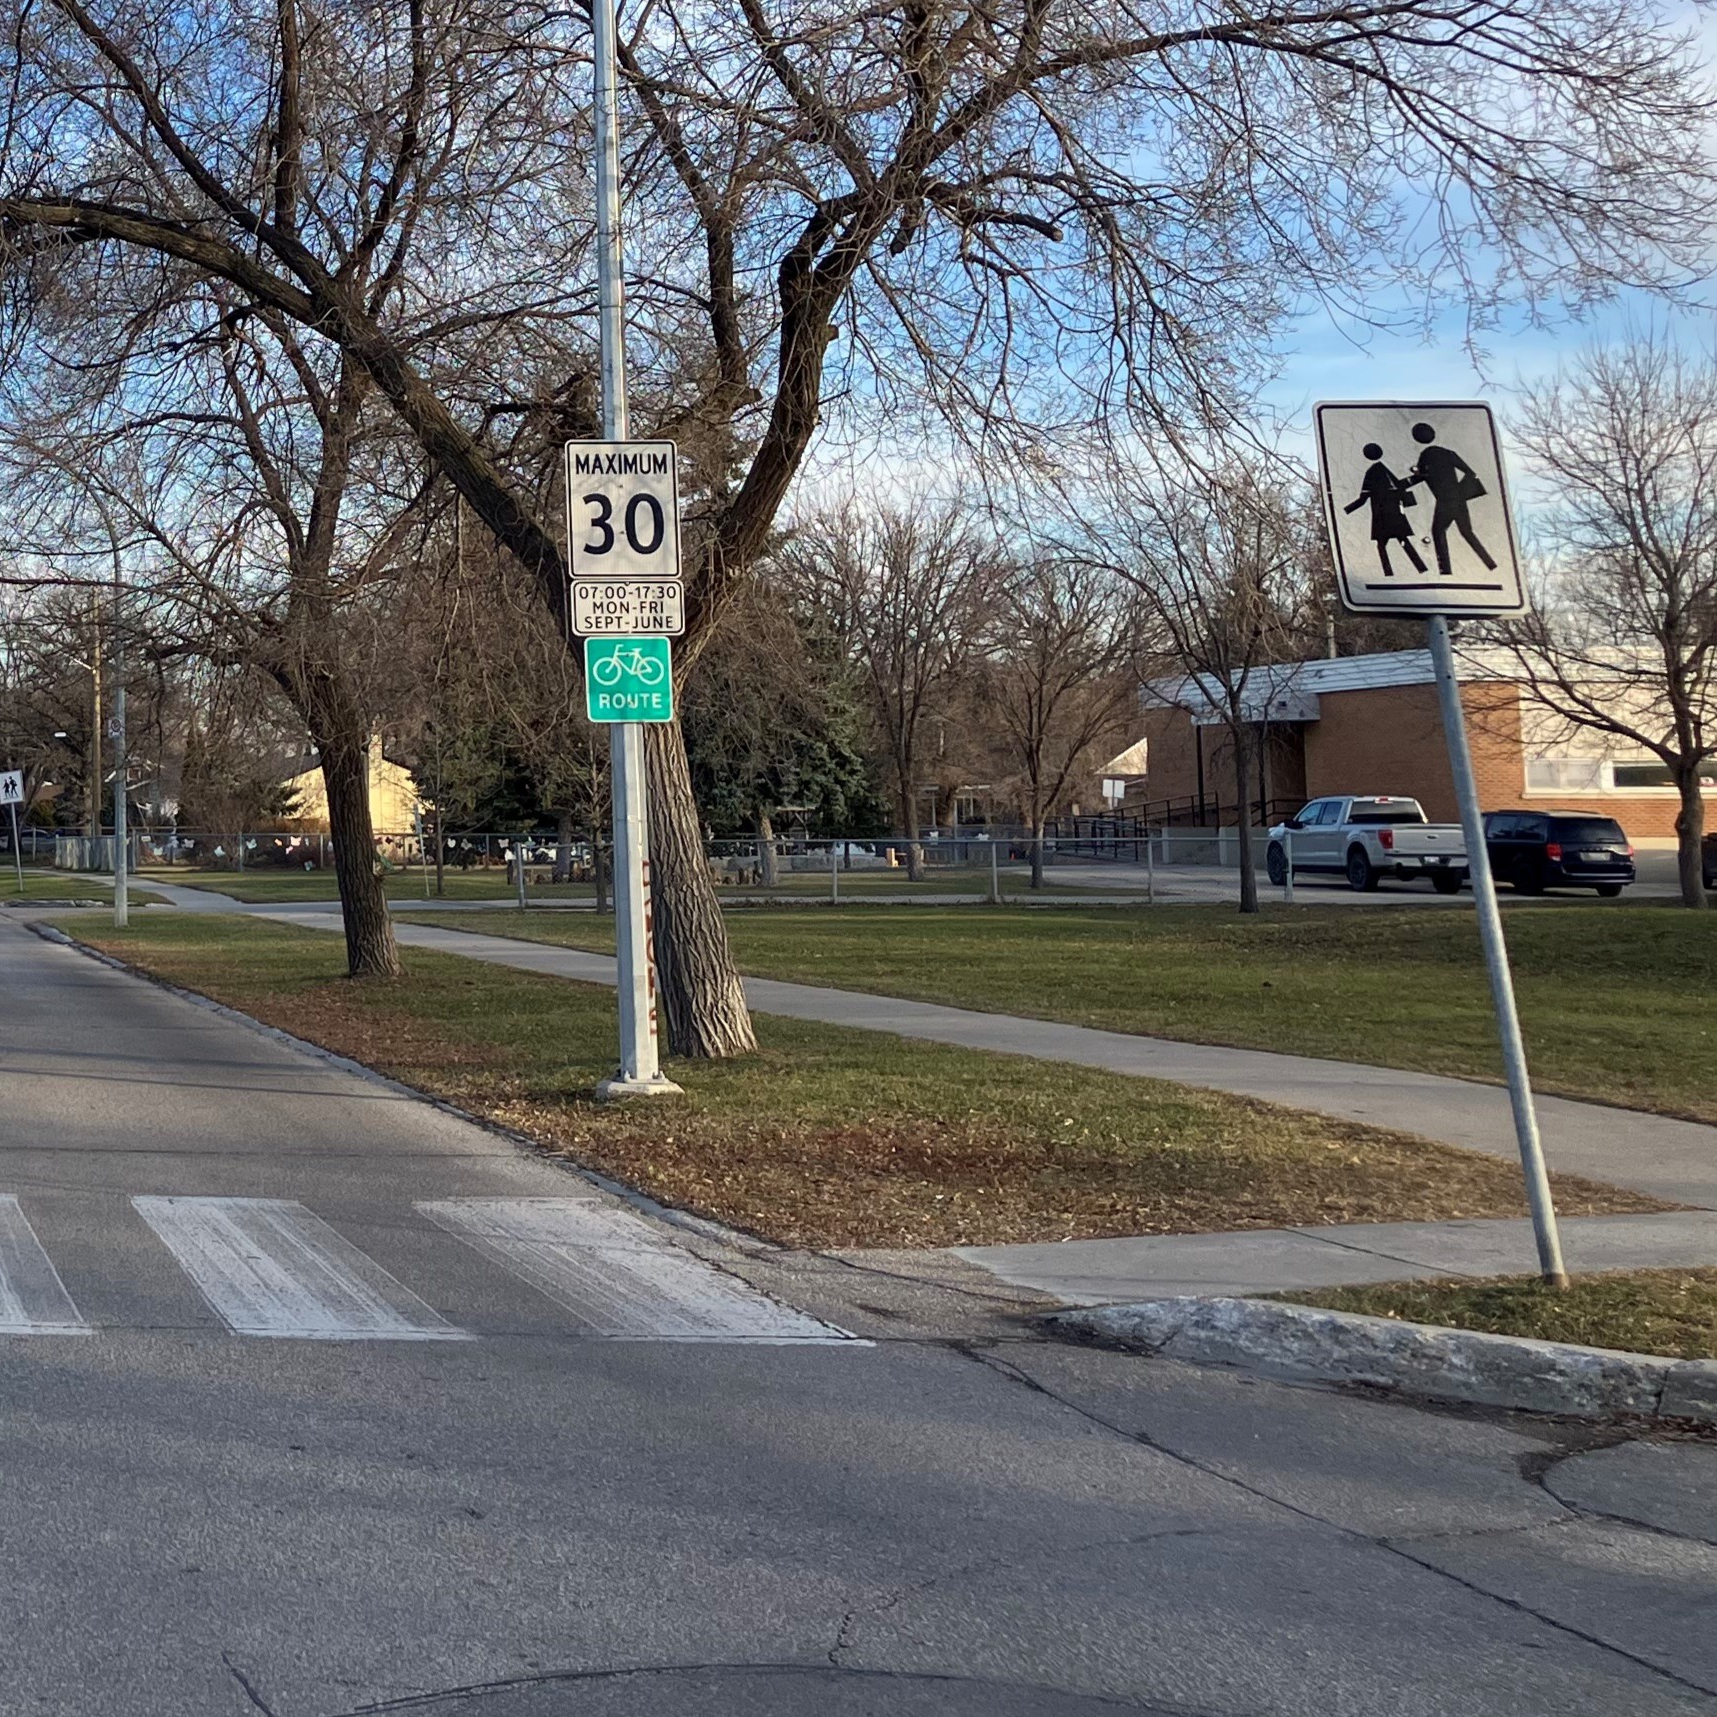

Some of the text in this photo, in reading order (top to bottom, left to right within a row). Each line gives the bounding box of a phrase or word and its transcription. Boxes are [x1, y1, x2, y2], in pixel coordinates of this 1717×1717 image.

[575, 453, 668, 475] MAXIMUM
[582, 493, 665, 555] 30
[579, 586, 677, 600] 07:00-17:30
[592, 601, 664, 614] MON-FRI
[584, 616, 674, 629] SEPT-JUNE
[599, 692, 663, 710] ROUTE
